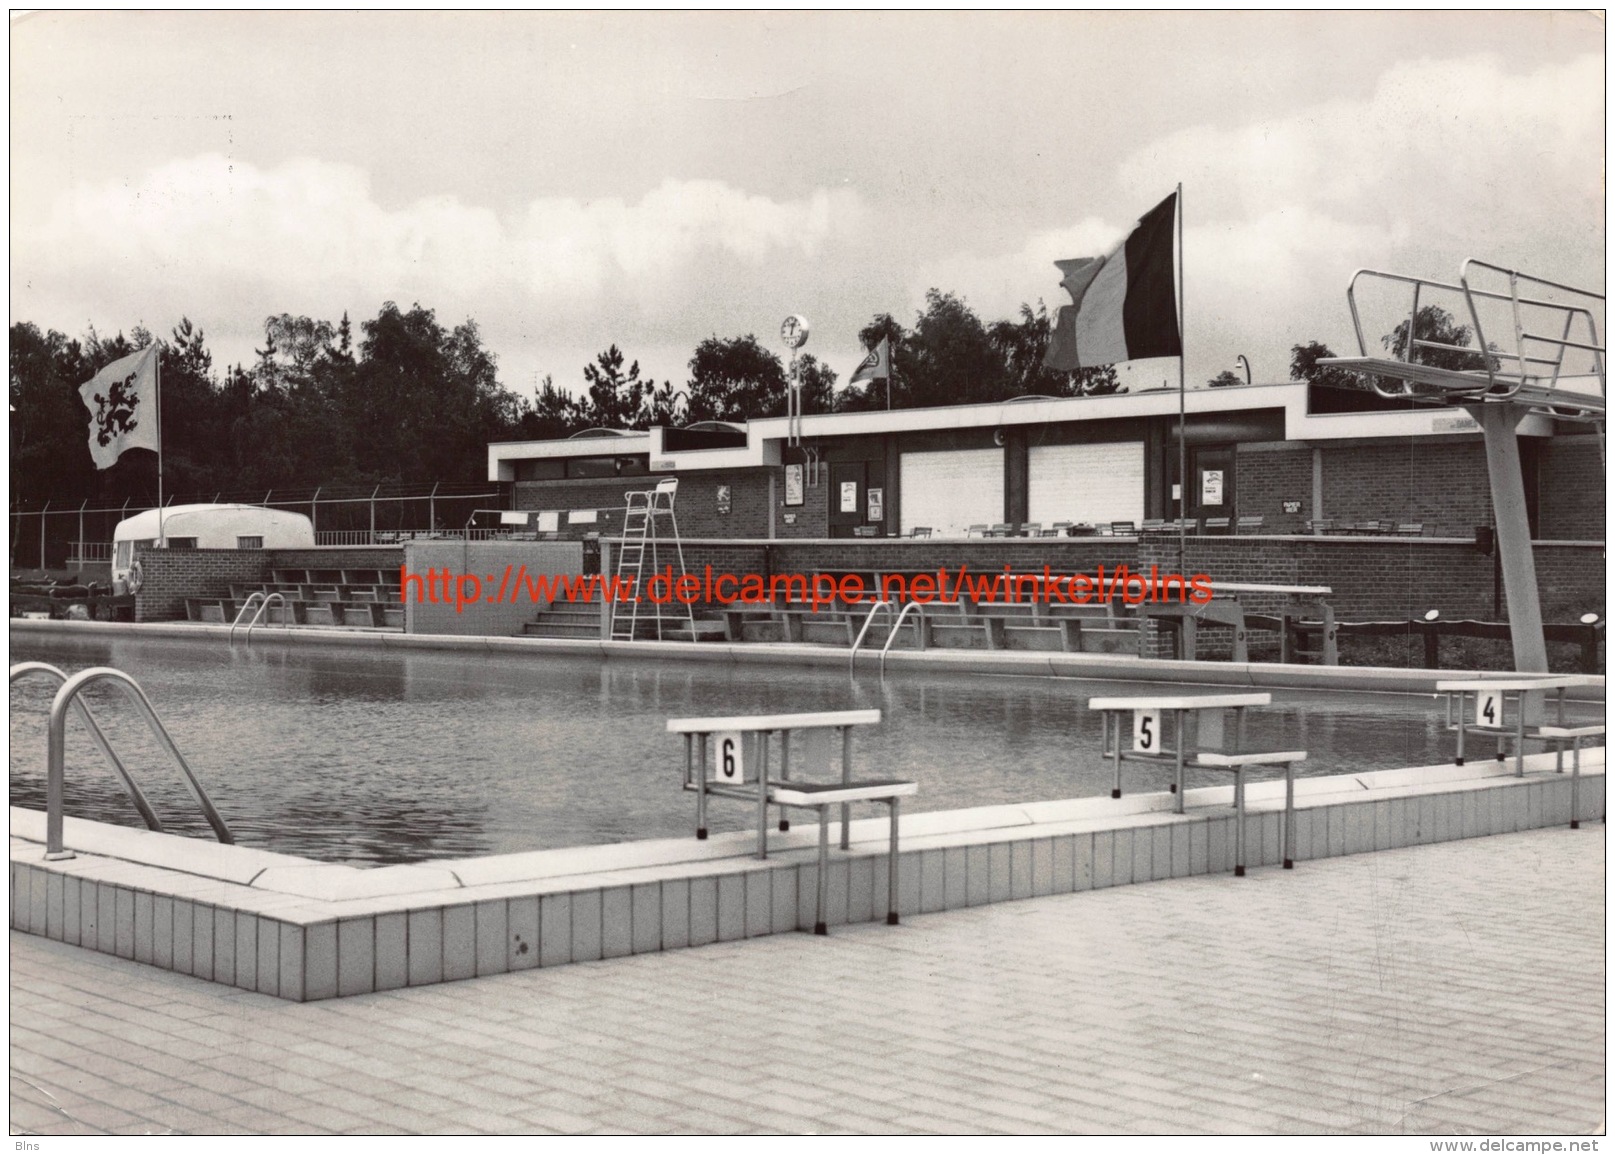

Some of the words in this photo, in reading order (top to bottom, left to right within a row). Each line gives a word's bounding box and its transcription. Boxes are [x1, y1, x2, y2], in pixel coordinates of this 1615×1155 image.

[1483, 696, 1495, 724] 4
[1140, 716, 1152, 749] 5
[723, 738, 735, 778] 6
